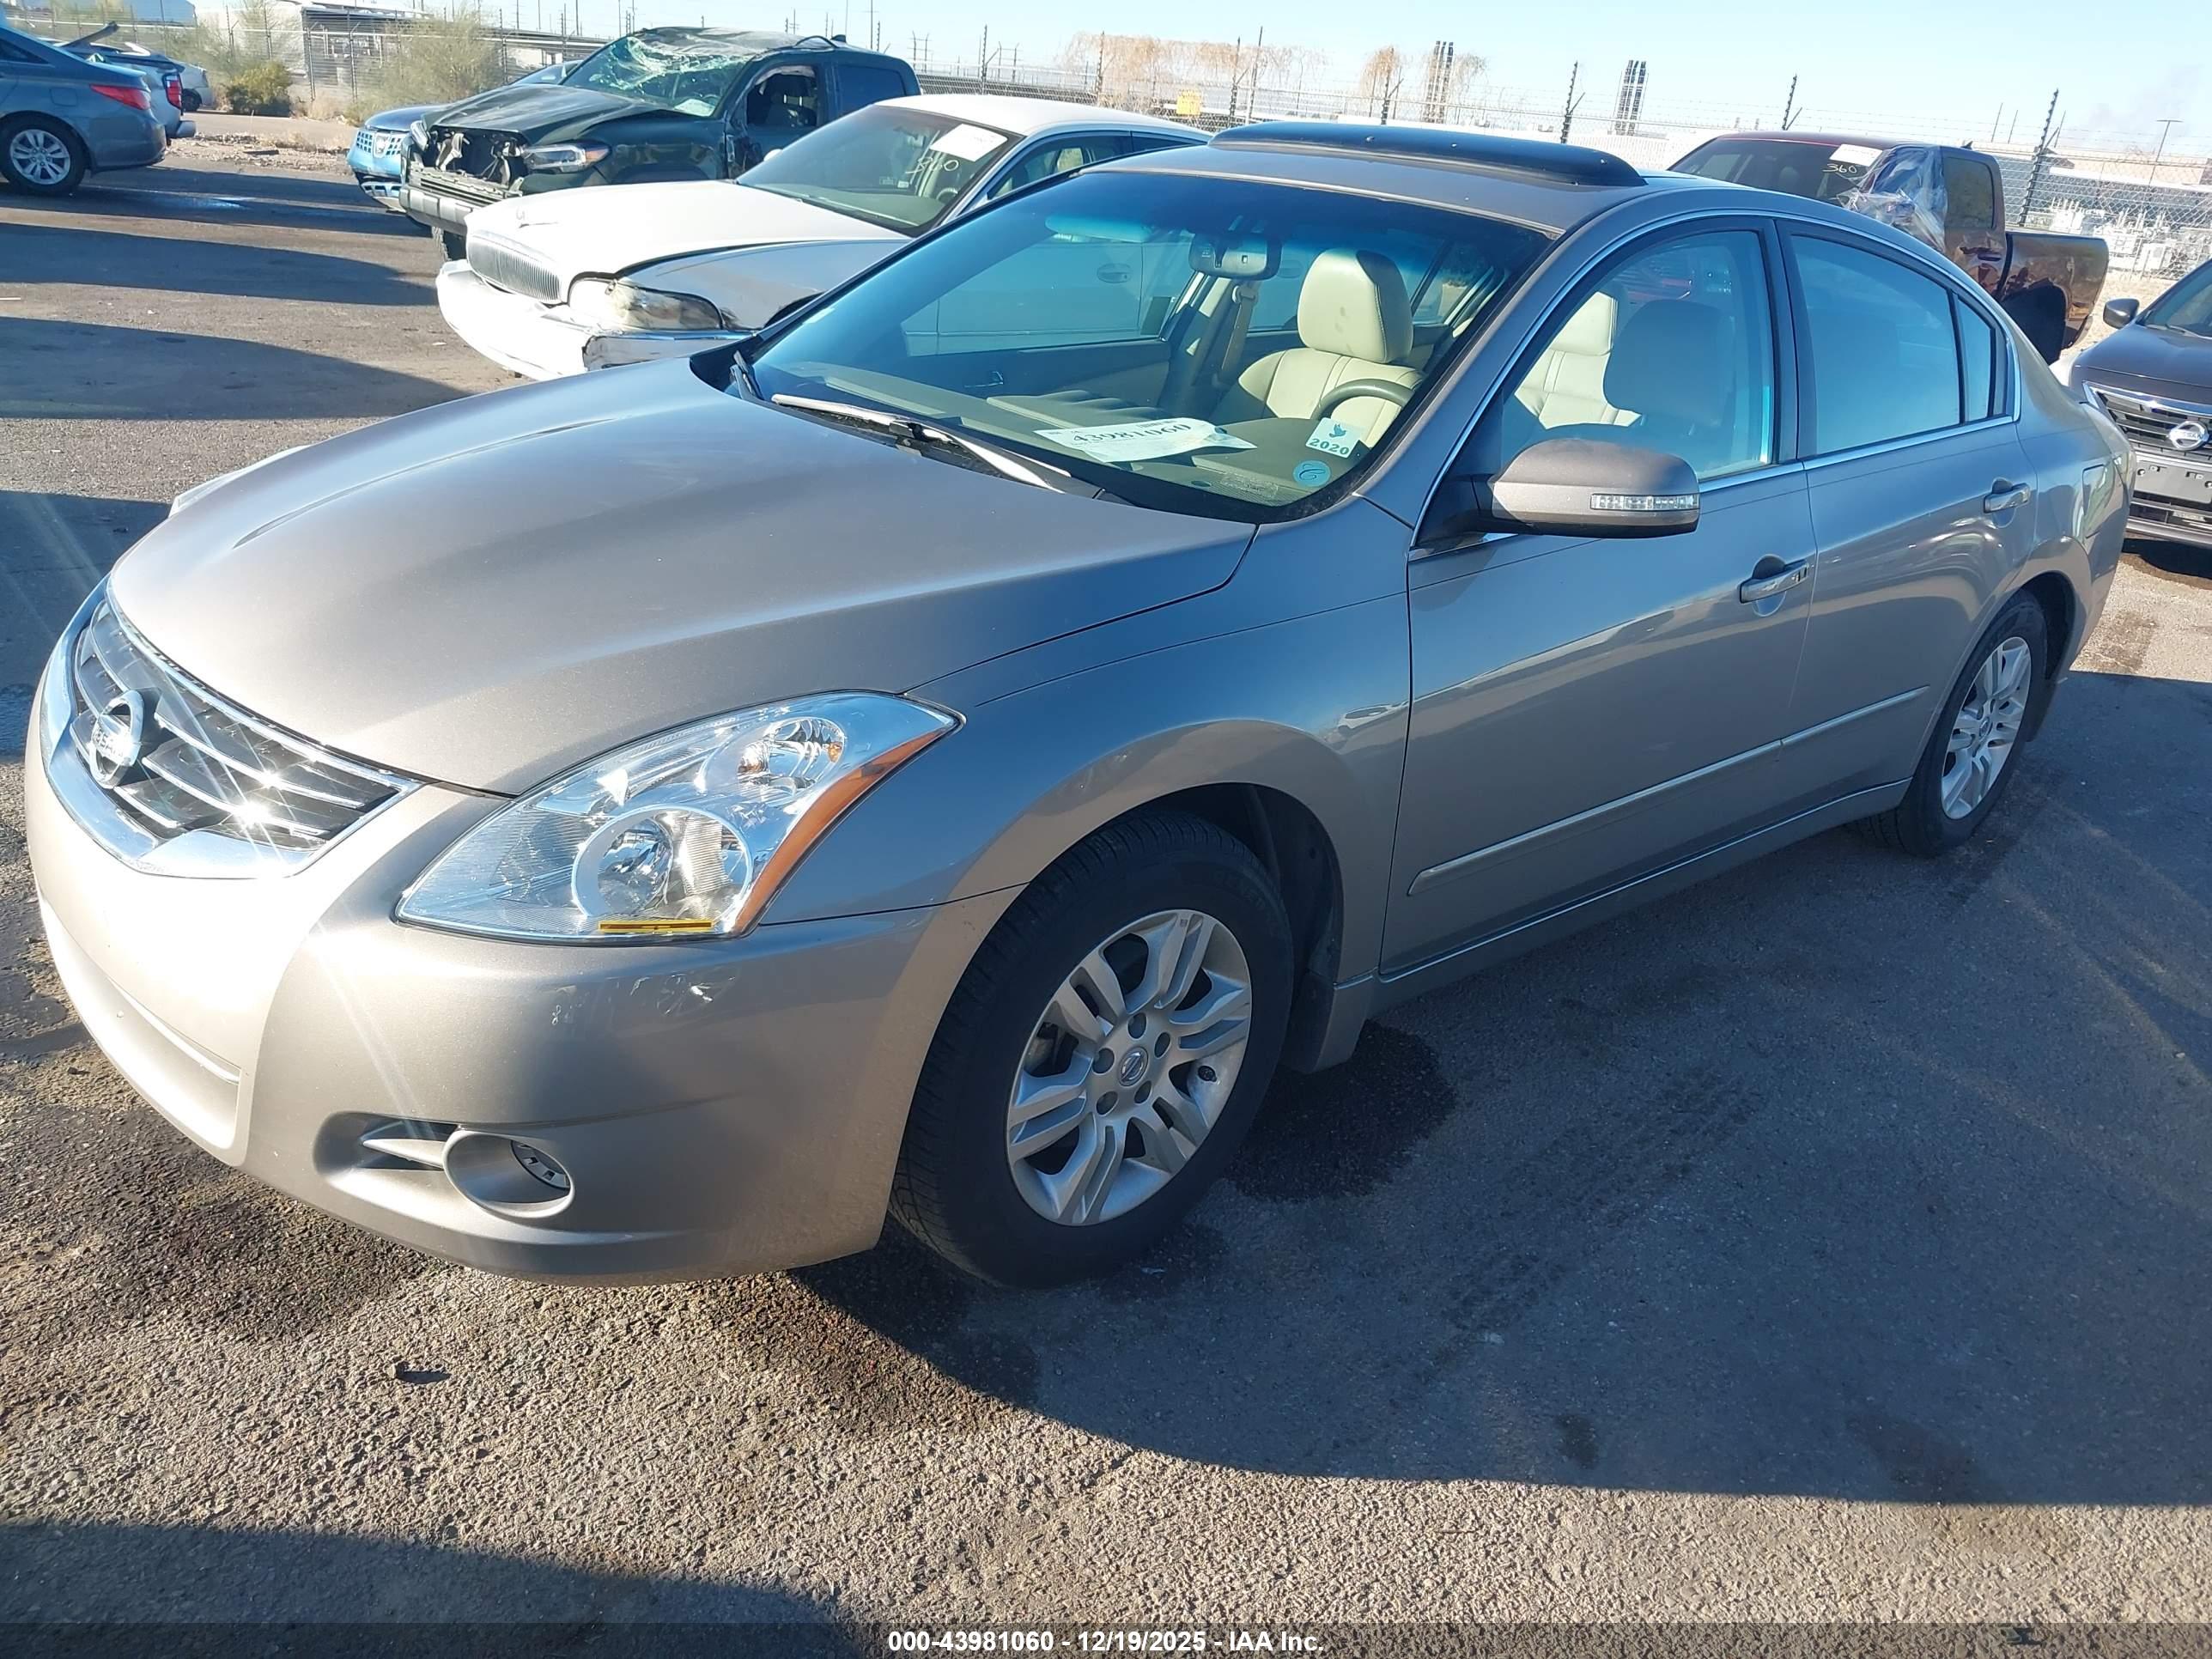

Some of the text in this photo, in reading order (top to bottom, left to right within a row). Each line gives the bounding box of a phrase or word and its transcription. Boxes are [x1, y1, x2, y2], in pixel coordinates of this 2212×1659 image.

[1822, 163, 1857, 173] 360
[1073, 423, 1191, 443] 43981060
[1310, 438, 1349, 455] 2020
